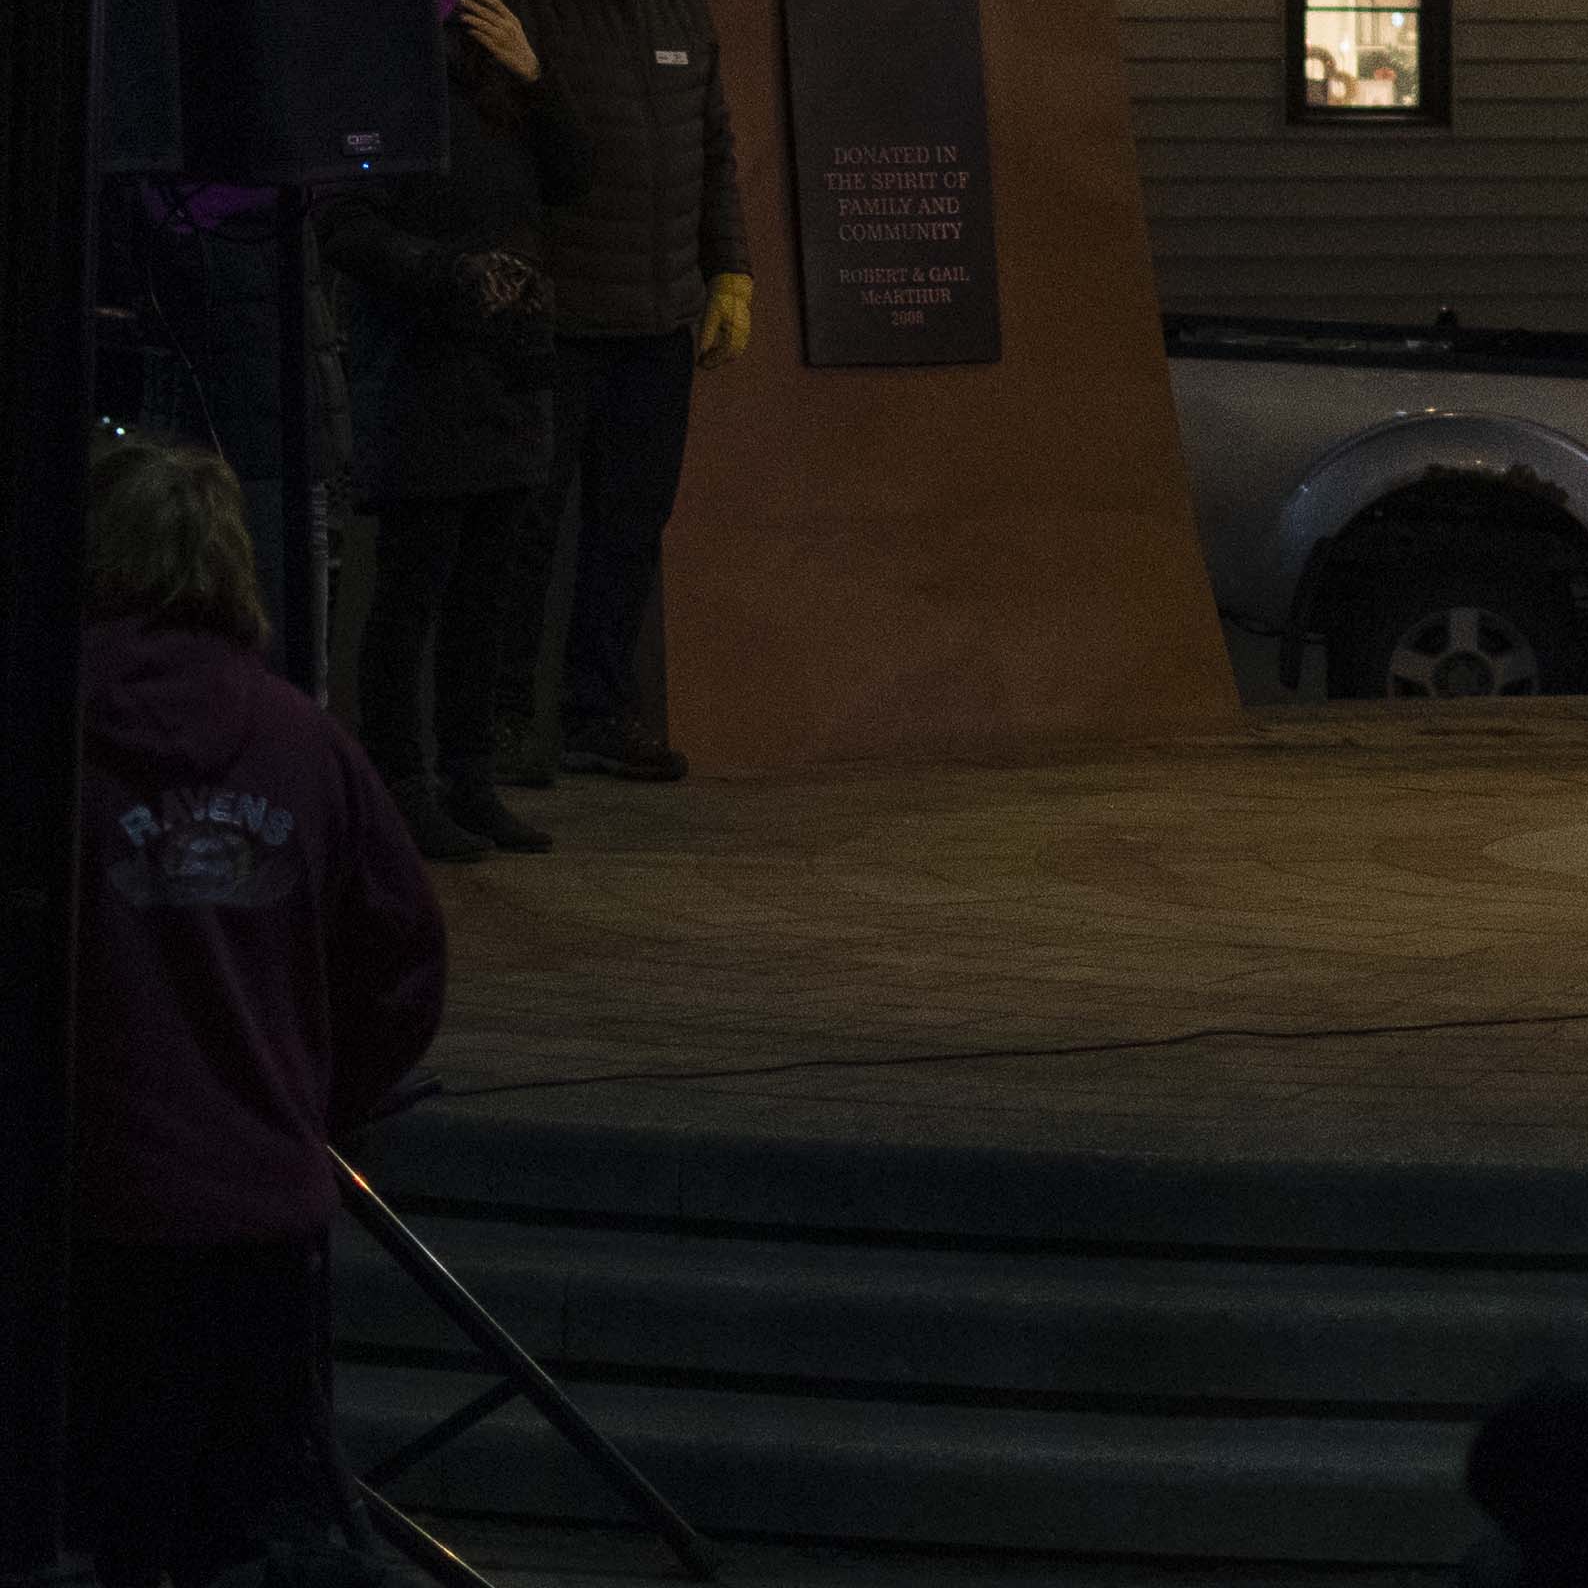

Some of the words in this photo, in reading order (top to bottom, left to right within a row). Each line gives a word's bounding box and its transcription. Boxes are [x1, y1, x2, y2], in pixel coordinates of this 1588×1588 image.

[834, 145, 930, 165] DONATED
[936, 145, 959, 164] IN
[825, 173, 866, 190] THE
[872, 171, 938, 190] SPIRIT
[943, 171, 970, 189] OF
[838, 198, 913, 216] FAMILY
[917, 197, 960, 215] AND
[839, 222, 963, 242] COMMUNITY
[839, 267, 908, 284] ROBERT
[912, 267, 925, 283] &
[928, 266, 971, 283] GAIL
[861, 287, 952, 306] McARTHUR
[118, 786, 296, 847] RAVENS
